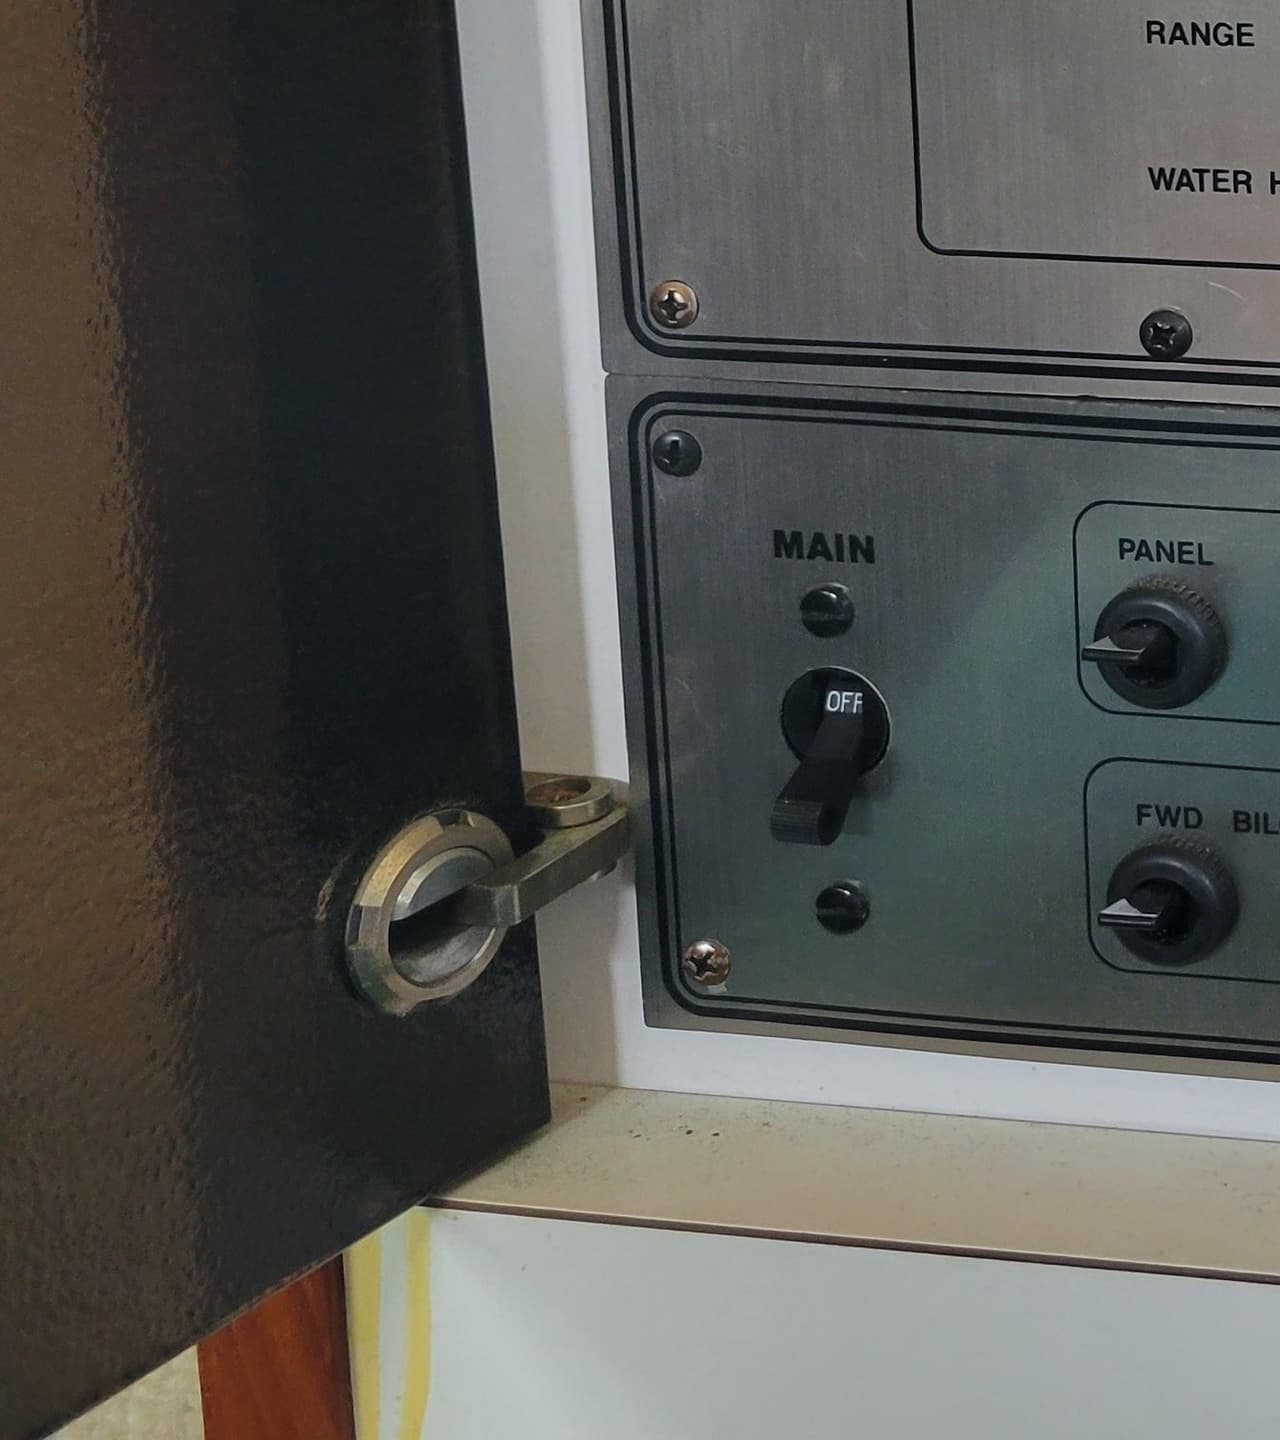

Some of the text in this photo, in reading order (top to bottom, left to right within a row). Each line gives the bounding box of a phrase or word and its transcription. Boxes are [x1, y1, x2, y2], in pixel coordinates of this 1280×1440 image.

[1146, 20, 1255, 48] RANGE
[1148, 166, 1253, 196] WATER
[773, 529, 876, 564] MAIN
[1118, 538, 1213, 566] PANEL
[825, 690, 863, 714] OFF
[1136, 803, 1203, 830] FWD
